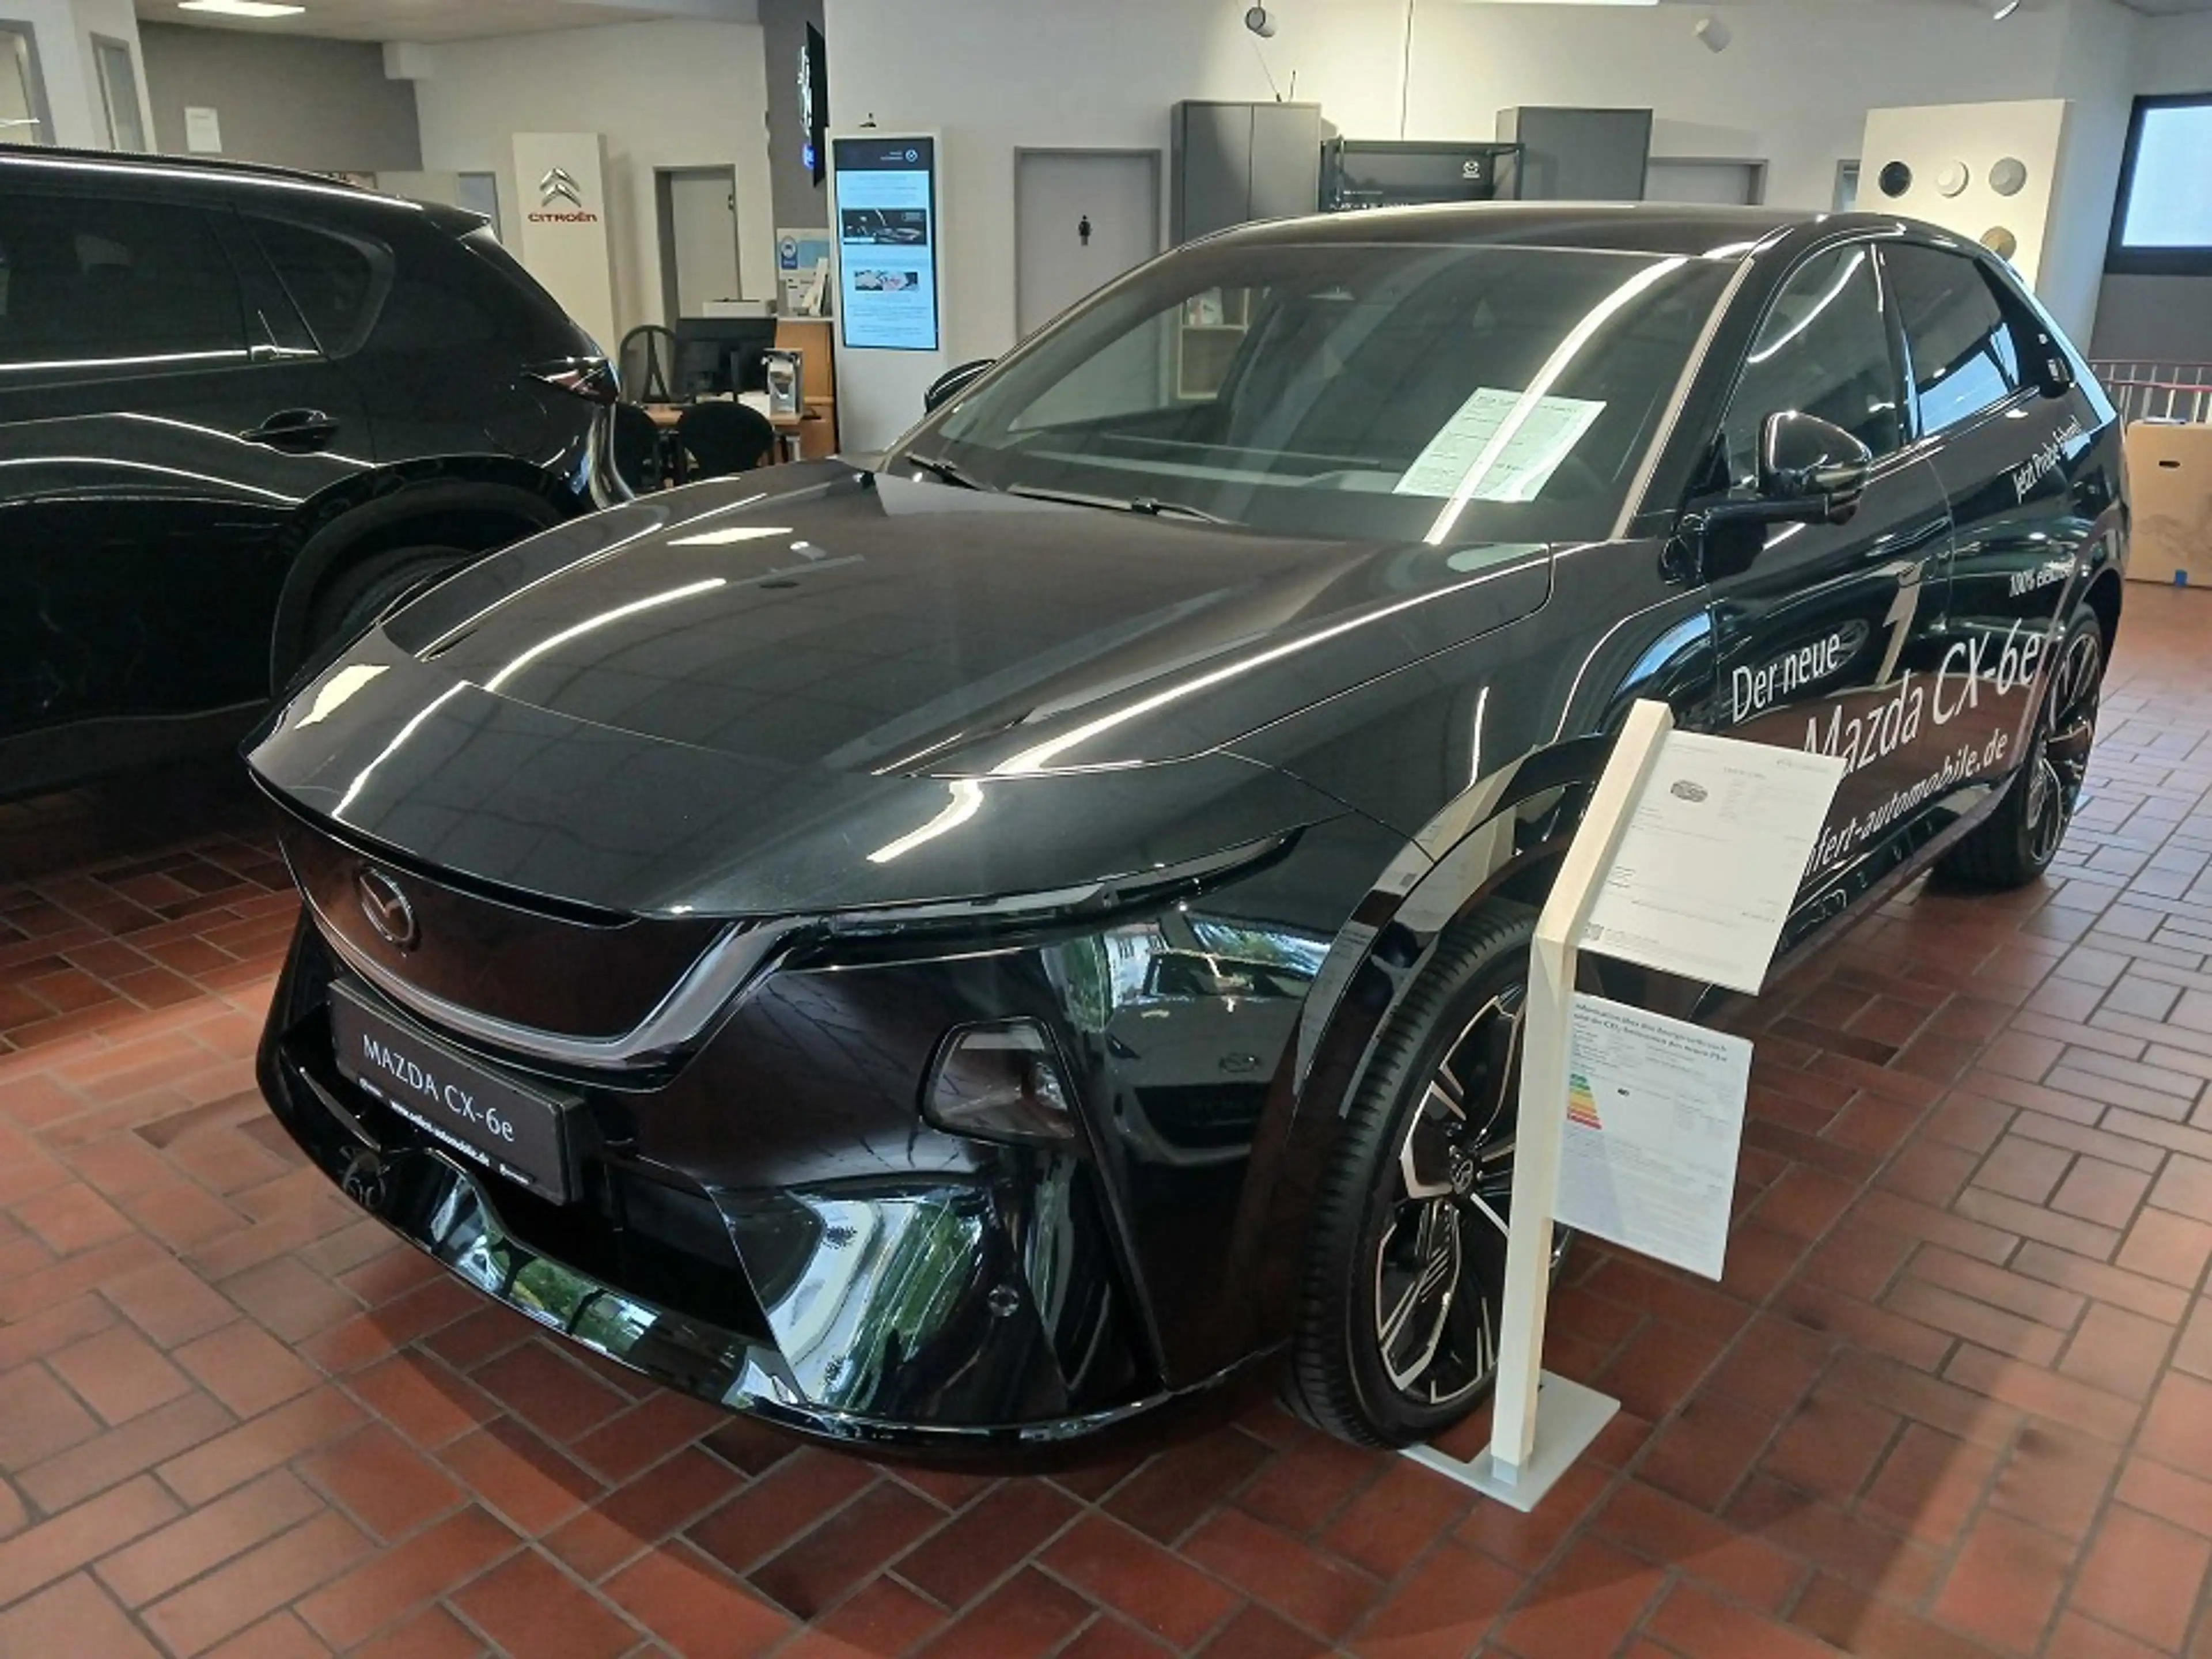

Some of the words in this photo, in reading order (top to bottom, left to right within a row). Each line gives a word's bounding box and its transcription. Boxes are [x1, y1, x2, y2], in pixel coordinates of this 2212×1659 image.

[1732, 664, 1776, 724] Der
[1783, 634, 1841, 694] neue
[1804, 669, 1924, 777] Mazda
[1933, 618, 2043, 725] CX-6e
[363, 1034, 440, 1101] MAZDA
[444, 1085, 514, 1142] CX-6e
